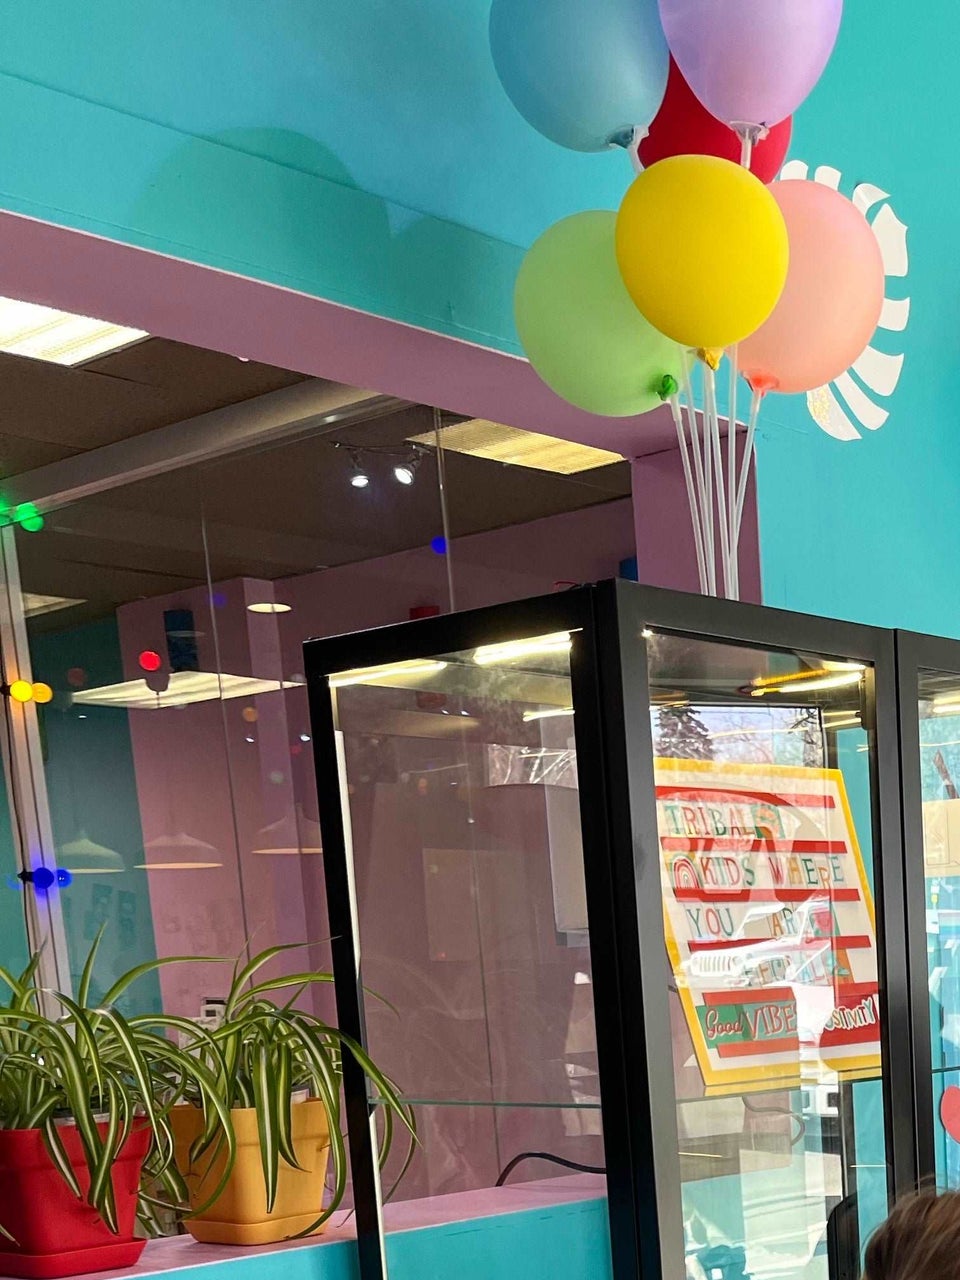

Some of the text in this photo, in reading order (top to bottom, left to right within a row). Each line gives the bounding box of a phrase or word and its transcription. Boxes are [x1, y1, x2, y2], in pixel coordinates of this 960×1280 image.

[663, 804, 756, 837] TRIBAL
[701, 856, 845, 889] KIDS WHERE
[686, 907, 799, 938] YOU AR
[705, 1008, 745, 1040] Good
[744, 1003, 797, 1041] VIBE
